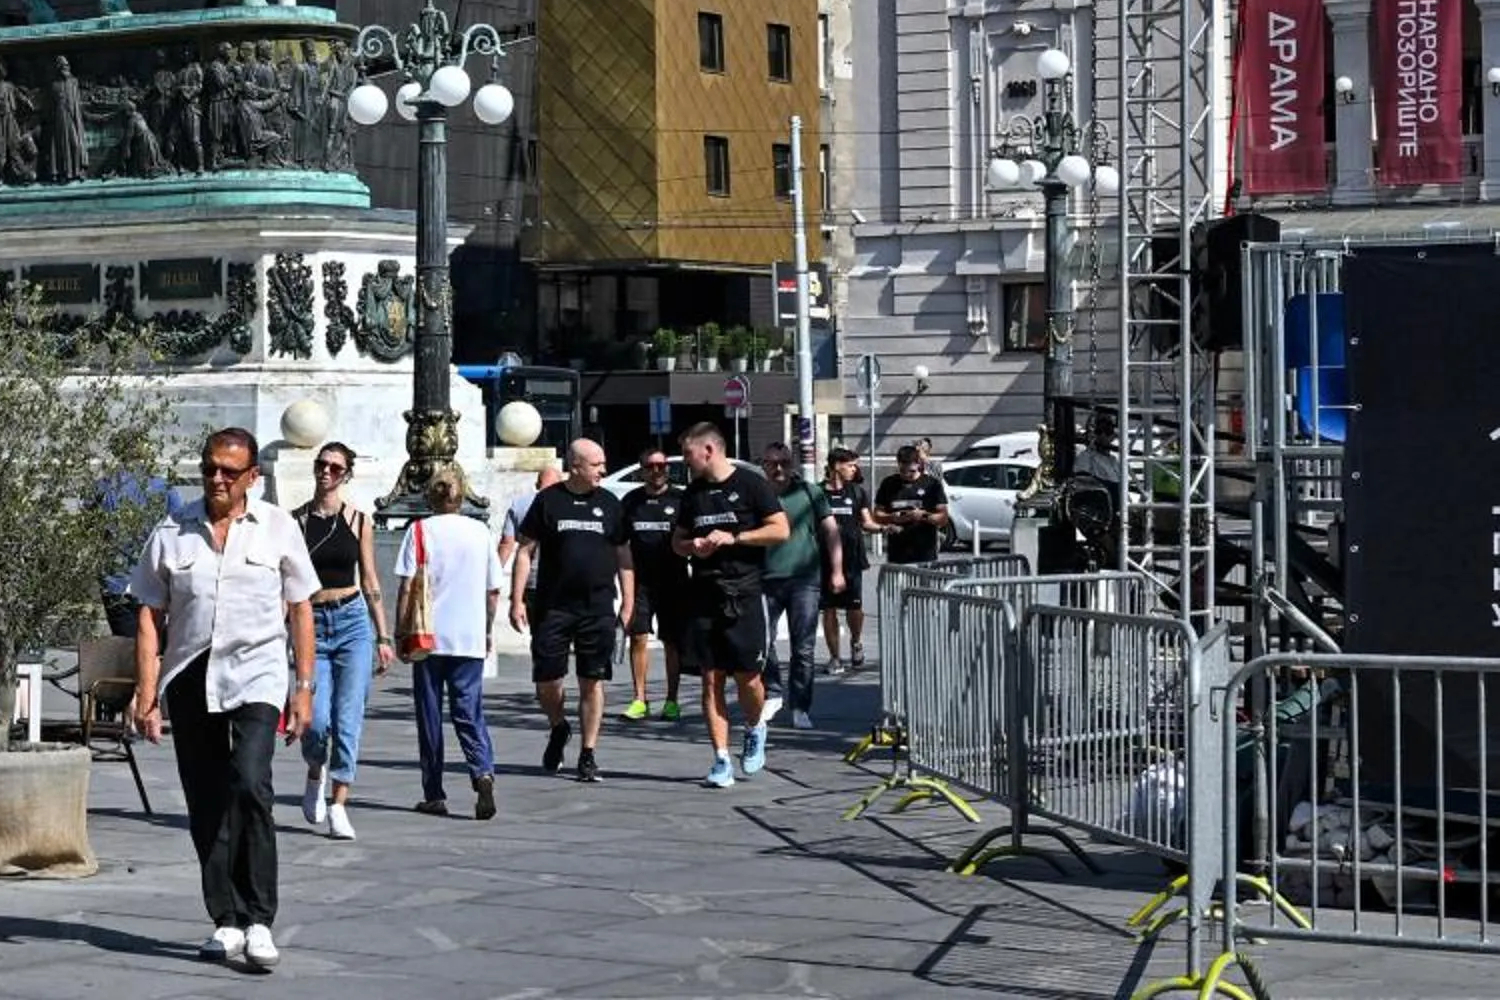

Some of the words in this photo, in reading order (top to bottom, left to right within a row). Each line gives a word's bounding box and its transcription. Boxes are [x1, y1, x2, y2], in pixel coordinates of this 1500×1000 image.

[1268, 11, 1298, 151] ДРАМА
[1397, 0, 1418, 157] ПОЗОРИШТЕ
[1418, 0, 1439, 123] НАРОДНО
